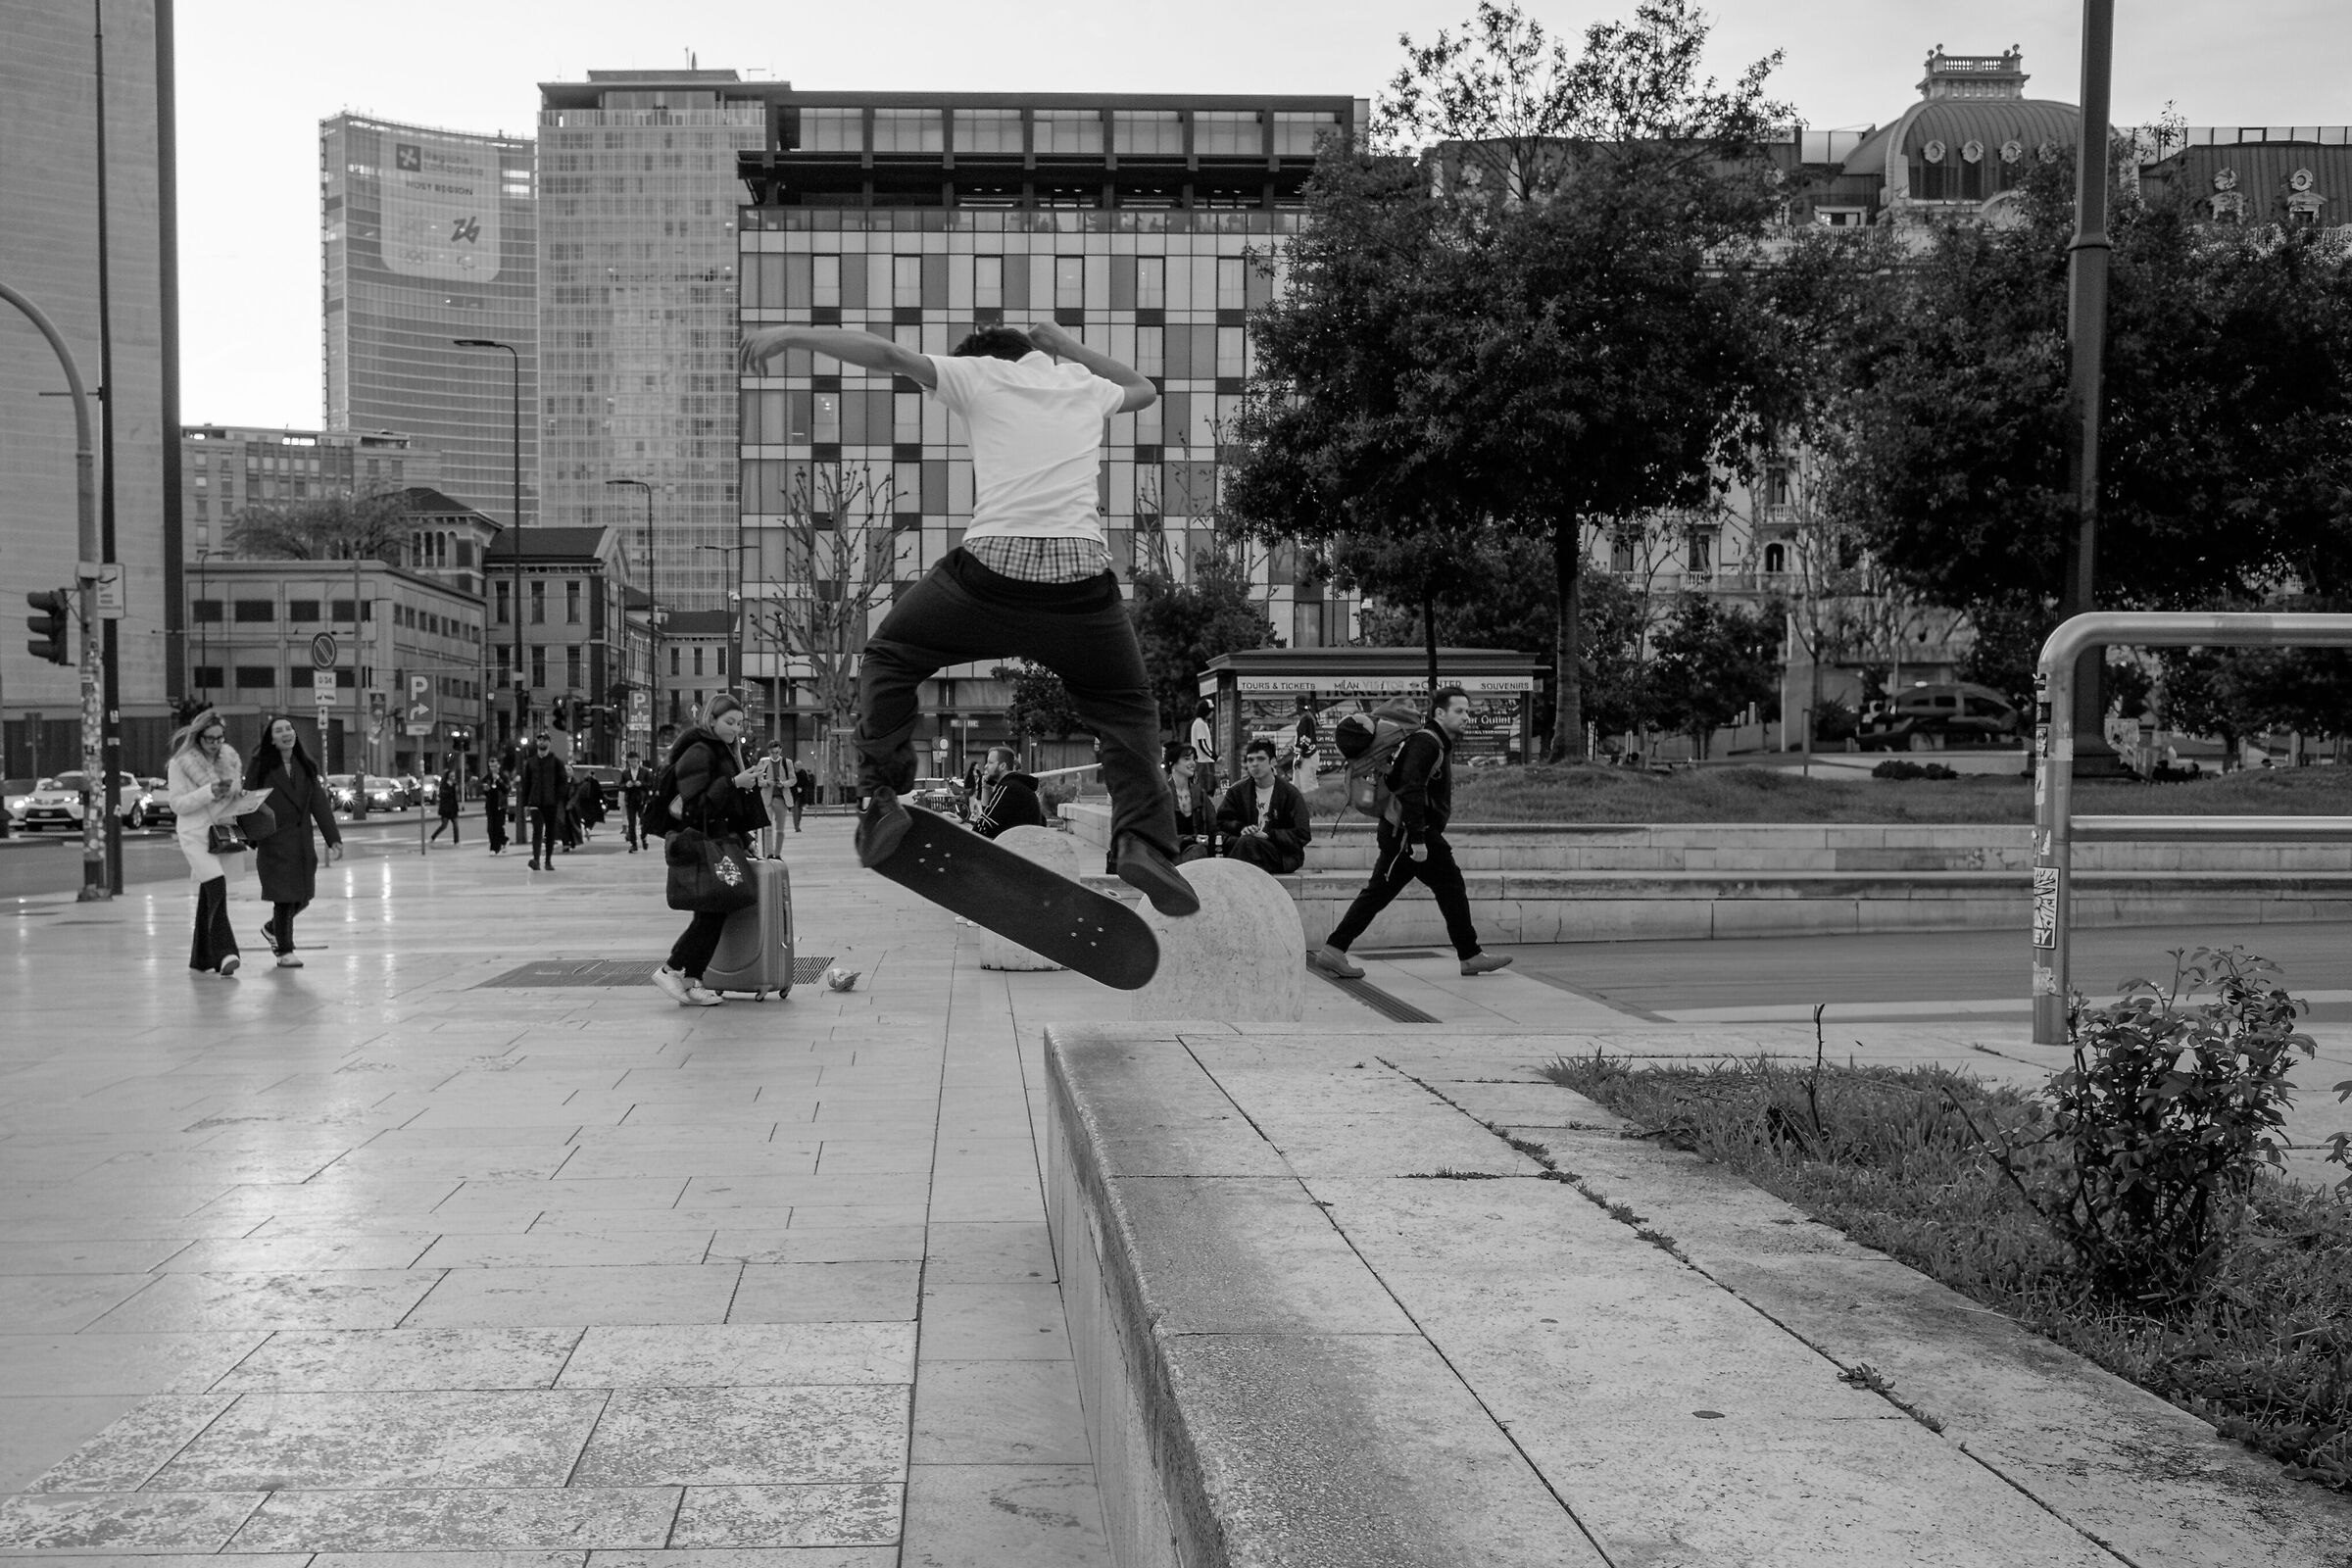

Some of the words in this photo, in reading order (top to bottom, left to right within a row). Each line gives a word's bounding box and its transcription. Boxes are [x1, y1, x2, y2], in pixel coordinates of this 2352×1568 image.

[434, 183, 473, 196] REGION
[411, 675, 428, 702] P
[1421, 679, 1462, 689] CNTER
[633, 693, 646, 709] P
